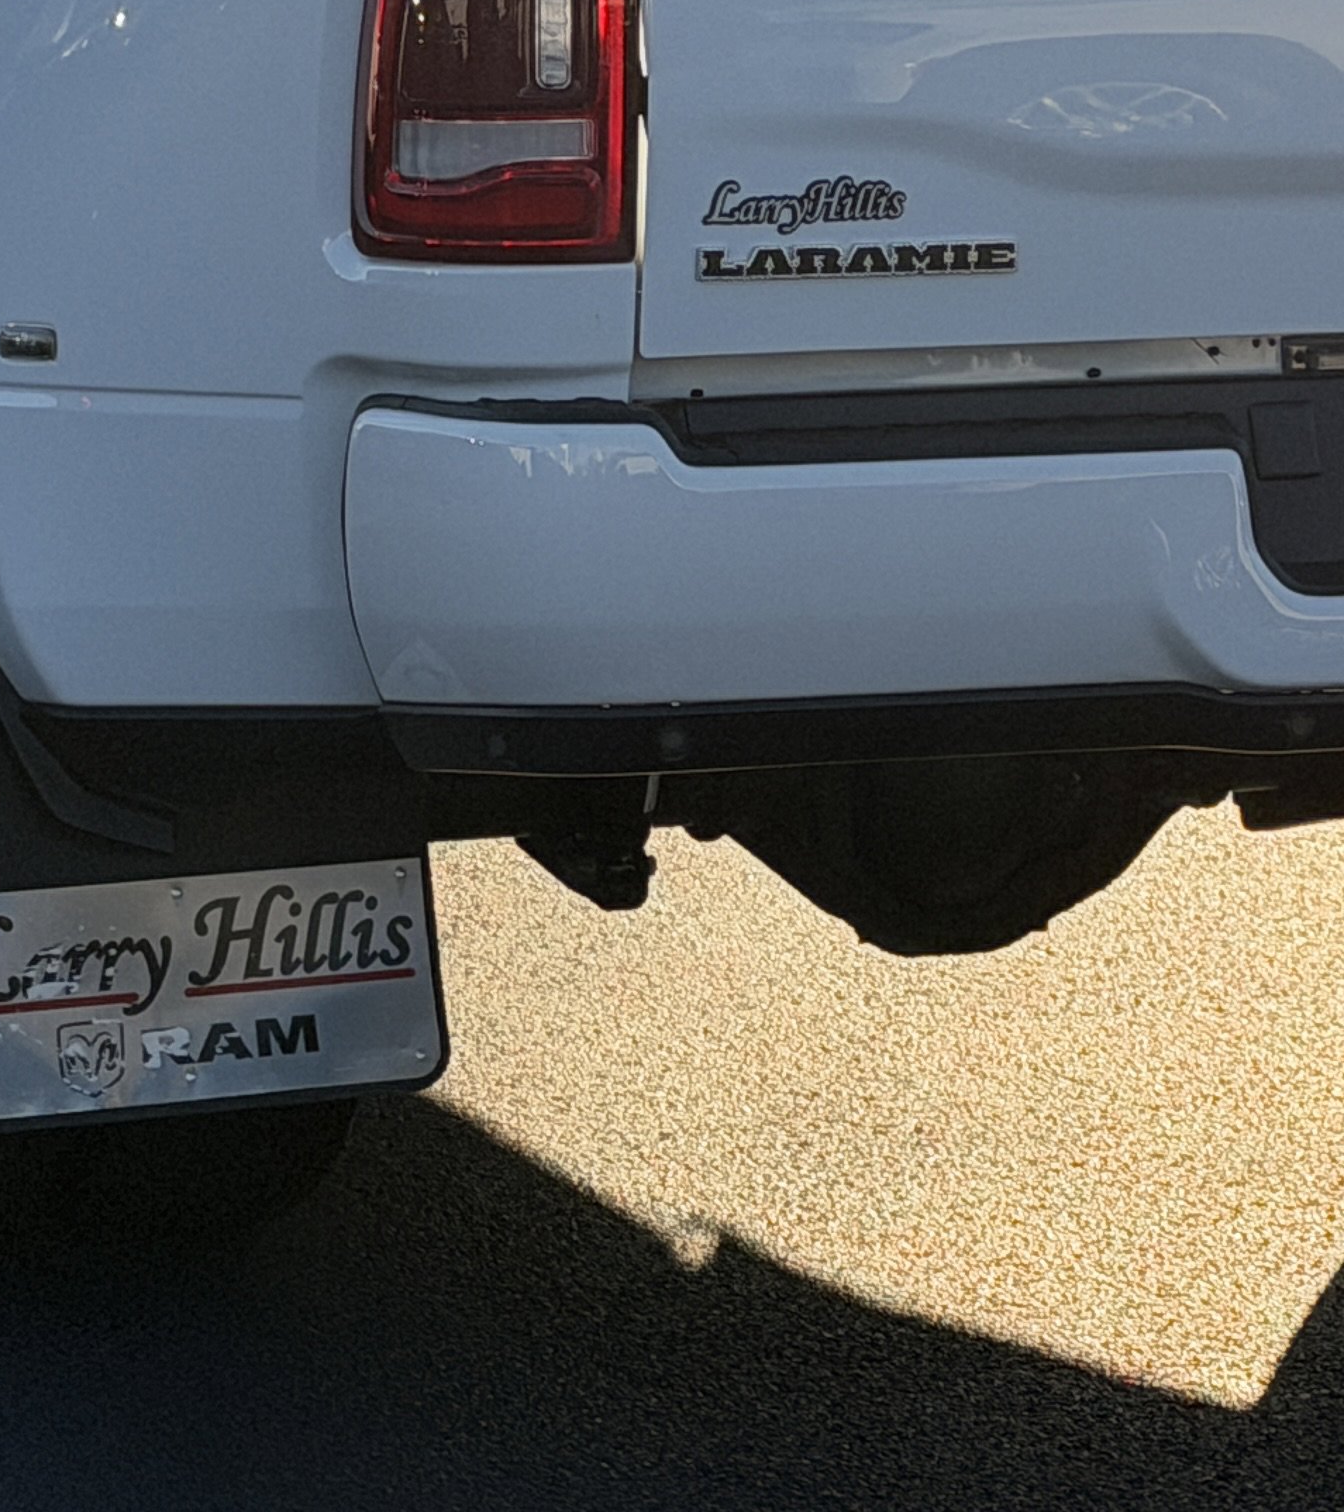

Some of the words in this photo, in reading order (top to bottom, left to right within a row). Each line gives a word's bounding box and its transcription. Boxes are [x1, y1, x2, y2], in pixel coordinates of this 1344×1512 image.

[697, 241, 1017, 281] LARAMIE
[188, 884, 414, 986] Hillis
[140, 1014, 321, 1069] RAM
